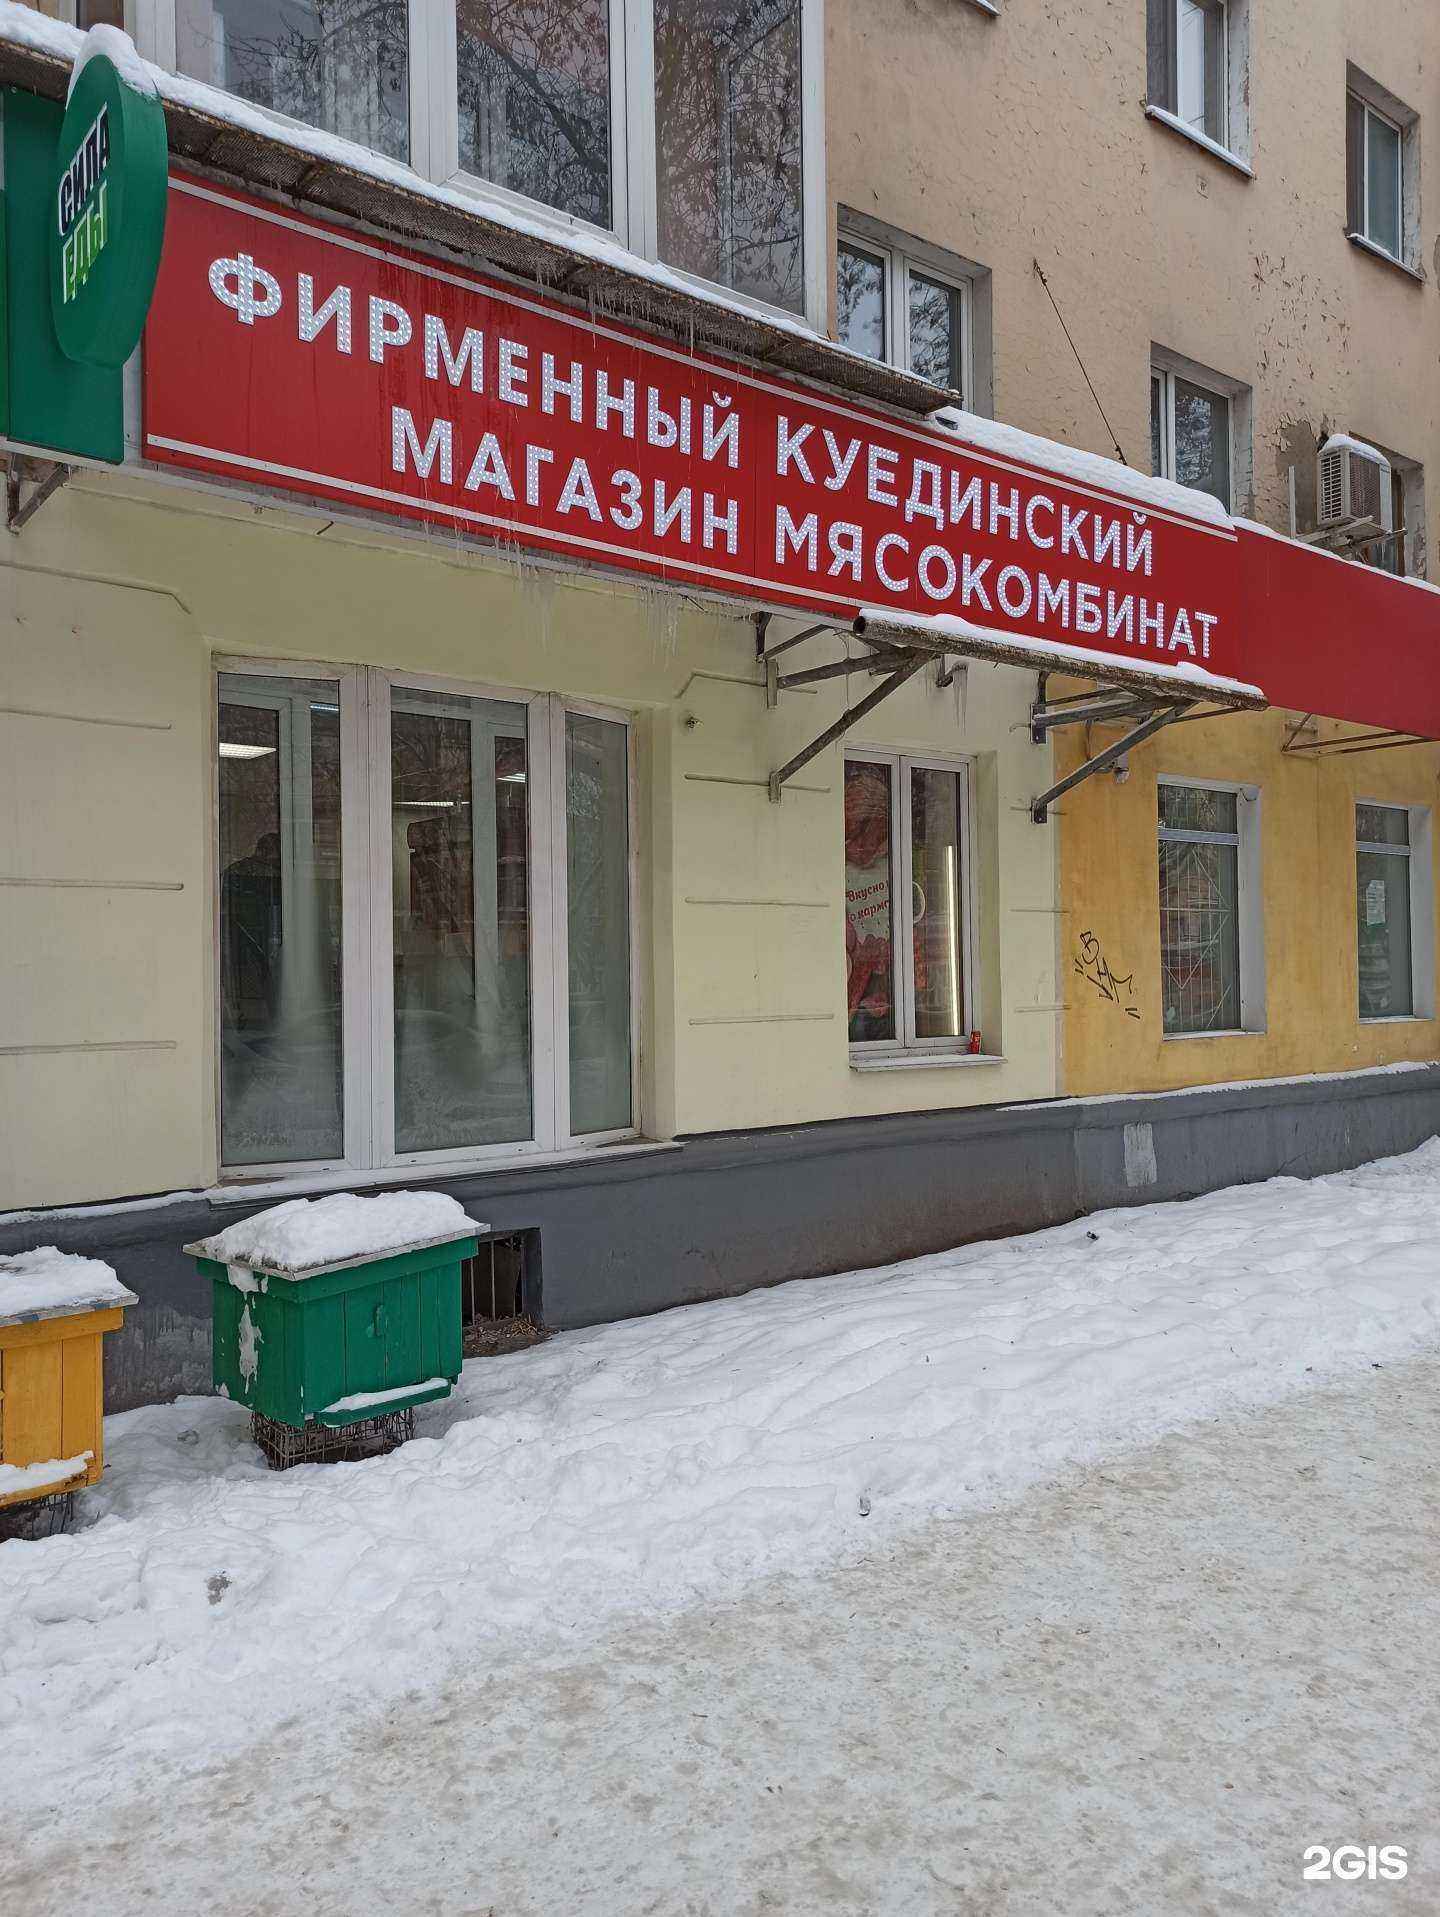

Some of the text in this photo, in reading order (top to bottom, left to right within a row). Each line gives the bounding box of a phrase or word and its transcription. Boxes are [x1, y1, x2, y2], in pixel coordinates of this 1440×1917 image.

[58, 101, 110, 236] СИЛА
[62, 178, 108, 304] ЕДЫ
[208, 252, 740, 469] ФИРМЕННЫЙ
[391, 405, 739, 555] МАГАЗИН
[776, 414, 1153, 577] КУЕДИНСКИЙ
[775, 505, 1218, 659] МЯСОКОМБИНАТ
